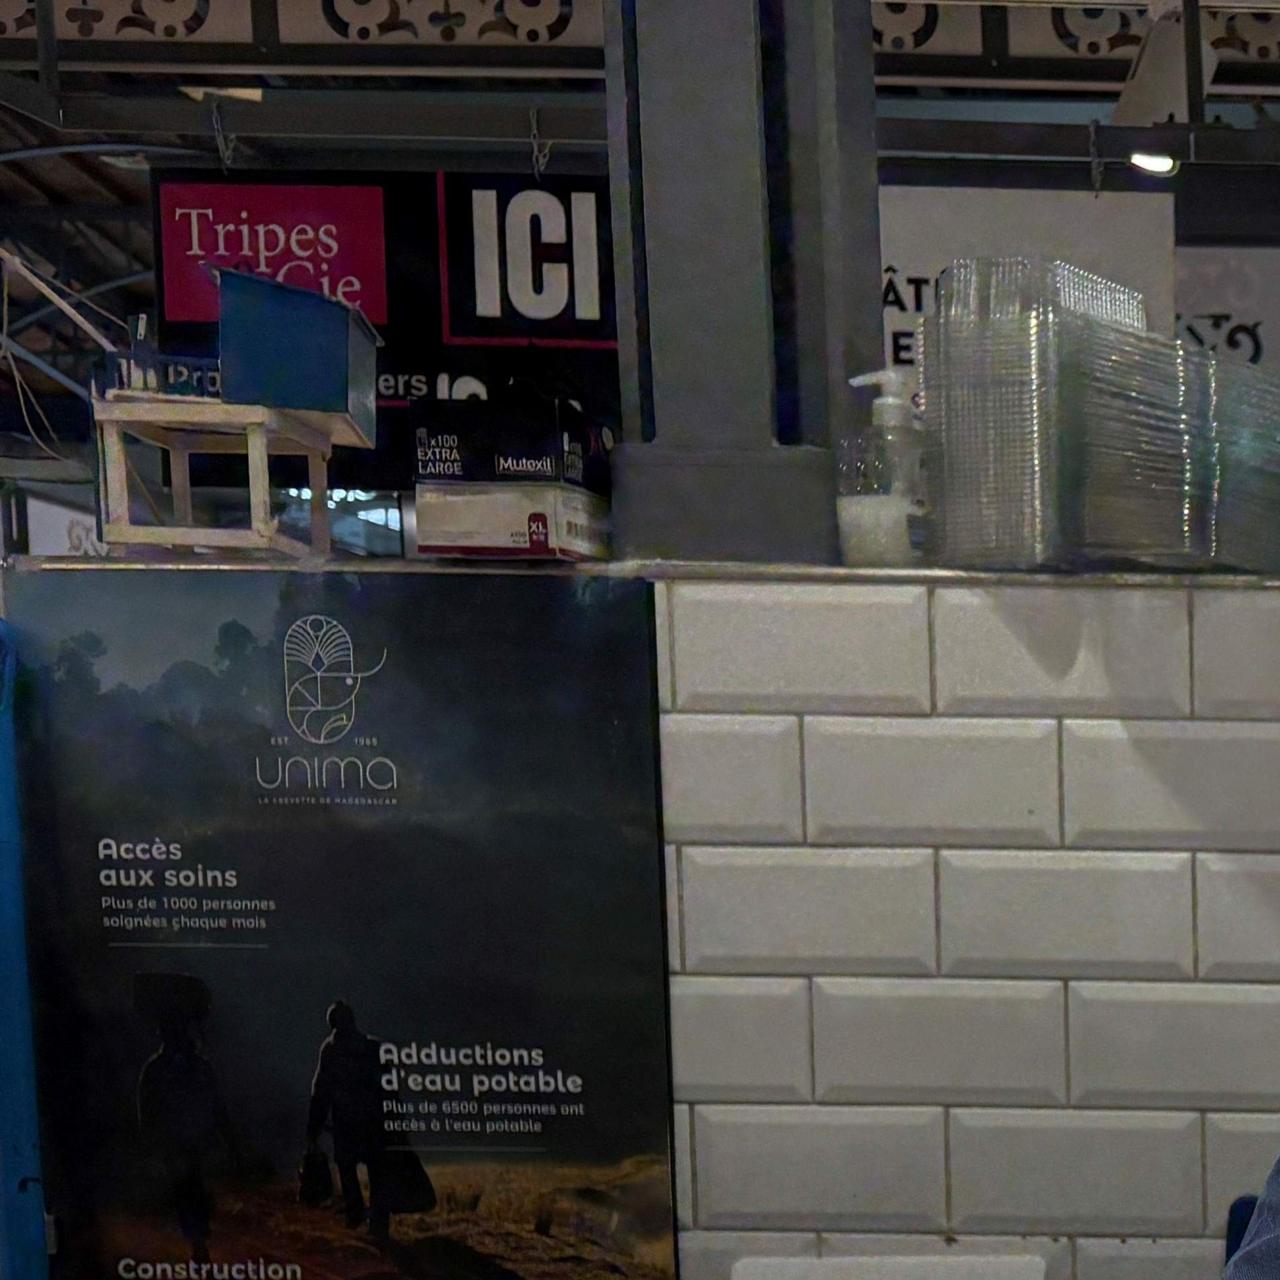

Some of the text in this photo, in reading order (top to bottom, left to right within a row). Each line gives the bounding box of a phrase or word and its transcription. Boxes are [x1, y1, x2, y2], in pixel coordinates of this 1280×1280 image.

[175, 207, 340, 274] Tripes
[471, 188, 600, 321] ICI
[417, 448, 461, 462] EXTRA
[418, 461, 464, 475] LARGE
[97, 836, 183, 861] Accès
[98, 862, 239, 888] aux soins
[101, 896, 277, 913] Plus de 1000 personnes
[103, 914, 168, 931] soignées
[232, 915, 267, 930] mois
[379, 1041, 545, 1067] Adductions
[381, 1068, 584, 1098] d'eau potable
[382, 1100, 415, 1115] Plus
[418, 1101, 438, 1115] de
[482, 1103, 558, 1117] personnes
[560, 1103, 586, 1117] ont
[383, 1118, 427, 1132] accès
[445, 1118, 481, 1132] l'eau
[485, 1119, 544, 1135] potable
[117, 1256, 303, 1280] Construction
